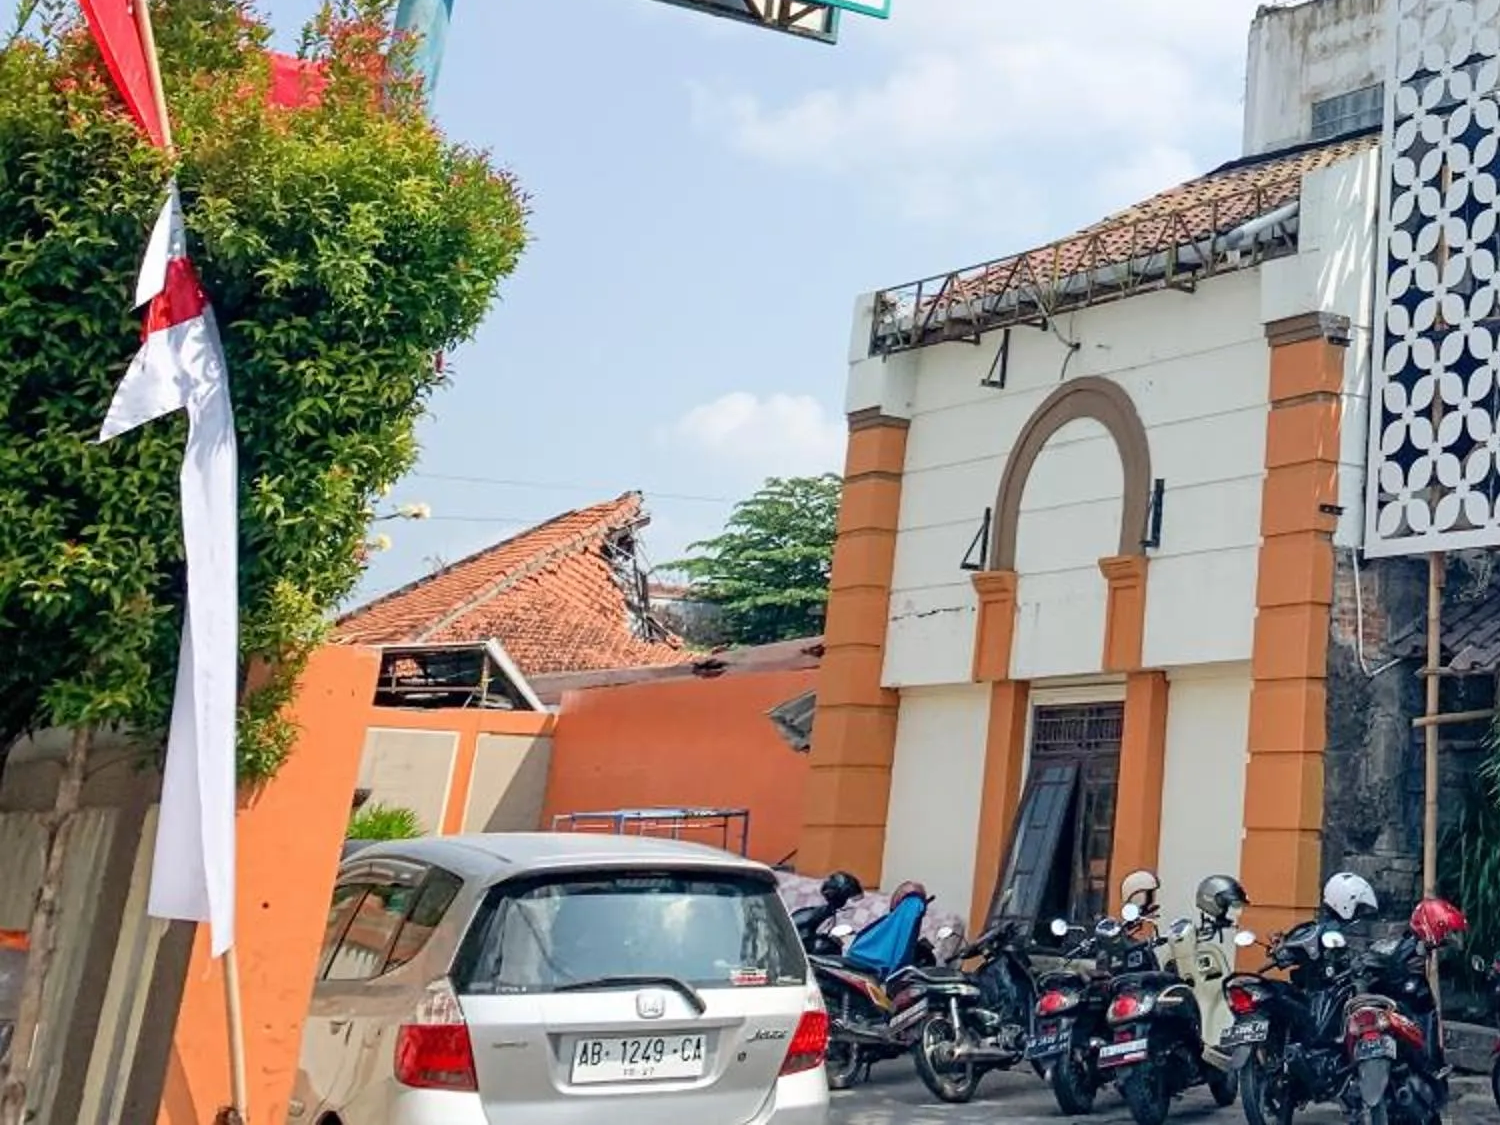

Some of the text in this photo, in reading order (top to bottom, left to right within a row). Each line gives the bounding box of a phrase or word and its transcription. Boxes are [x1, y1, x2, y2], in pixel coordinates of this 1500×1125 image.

[578, 1037, 702, 1066] AB 1249 CA
